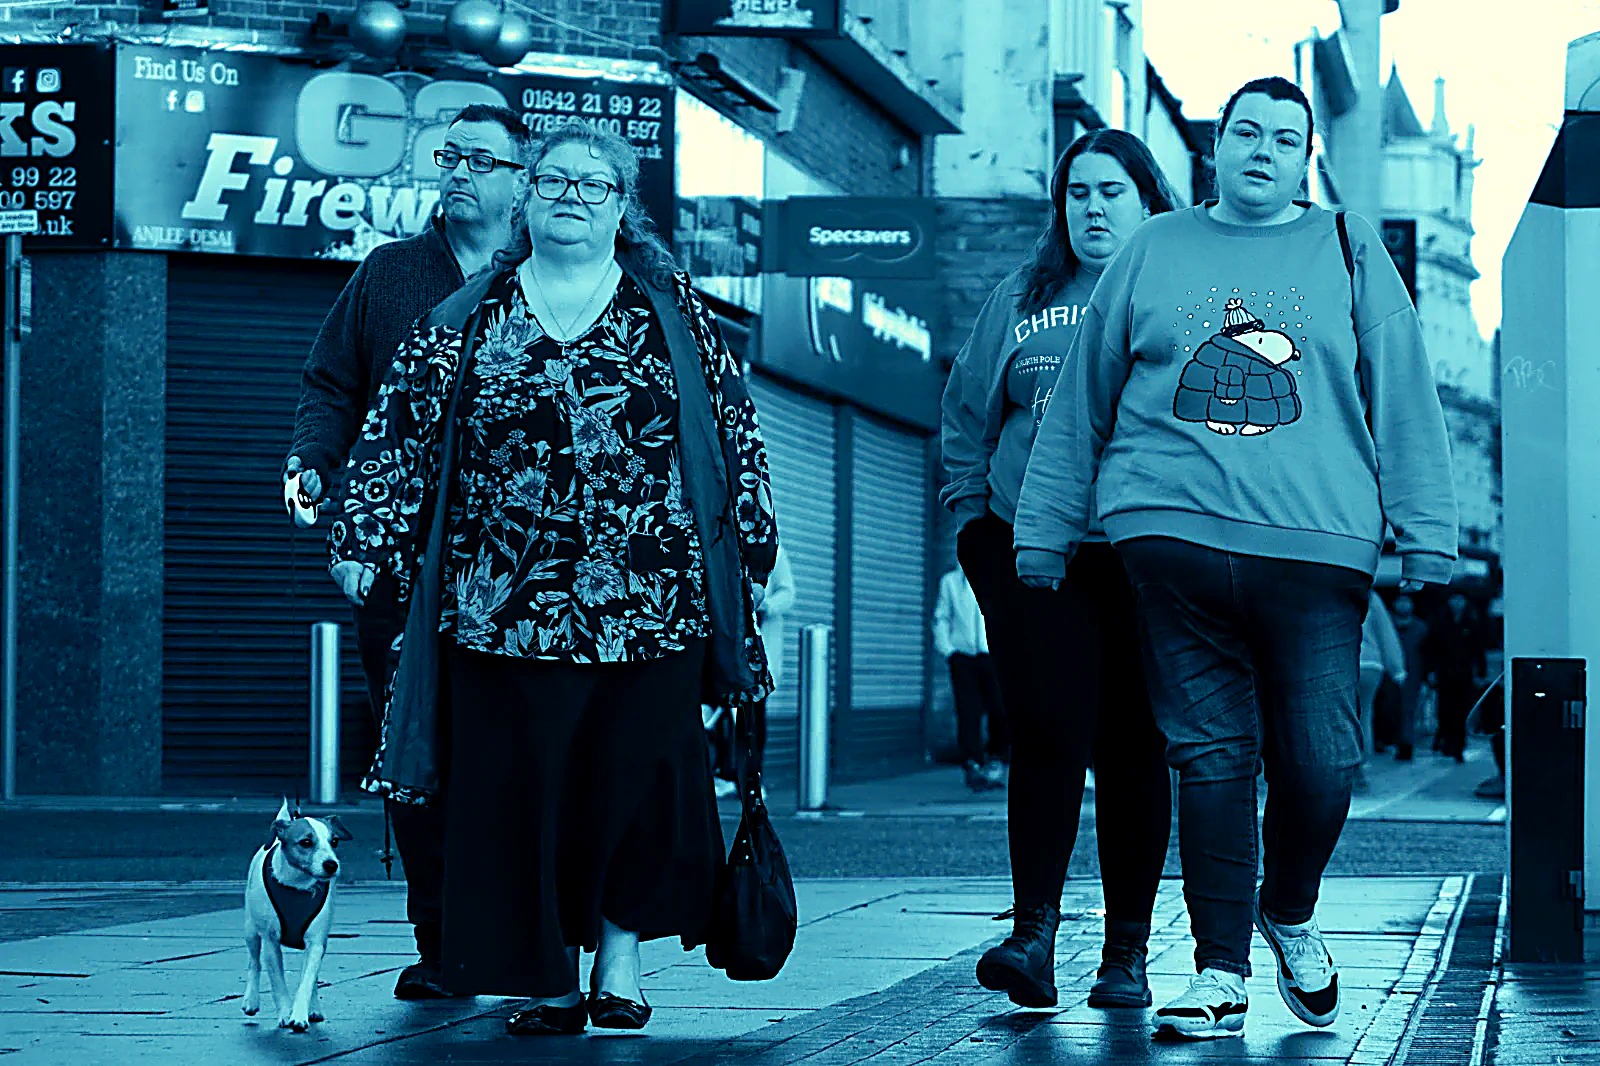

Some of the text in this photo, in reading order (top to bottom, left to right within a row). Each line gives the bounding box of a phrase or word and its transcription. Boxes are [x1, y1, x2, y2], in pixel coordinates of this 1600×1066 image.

[134, 55, 239, 86] Find Us On
[522, 88, 662, 118] 01642 21 99 22
[626, 119, 661, 141] 597
[11, 166, 77, 187] 99 22
[35, 190, 76, 210] 597
[809, 226, 911, 245] Specsavers
[1039, 355, 1061, 364] POLE
